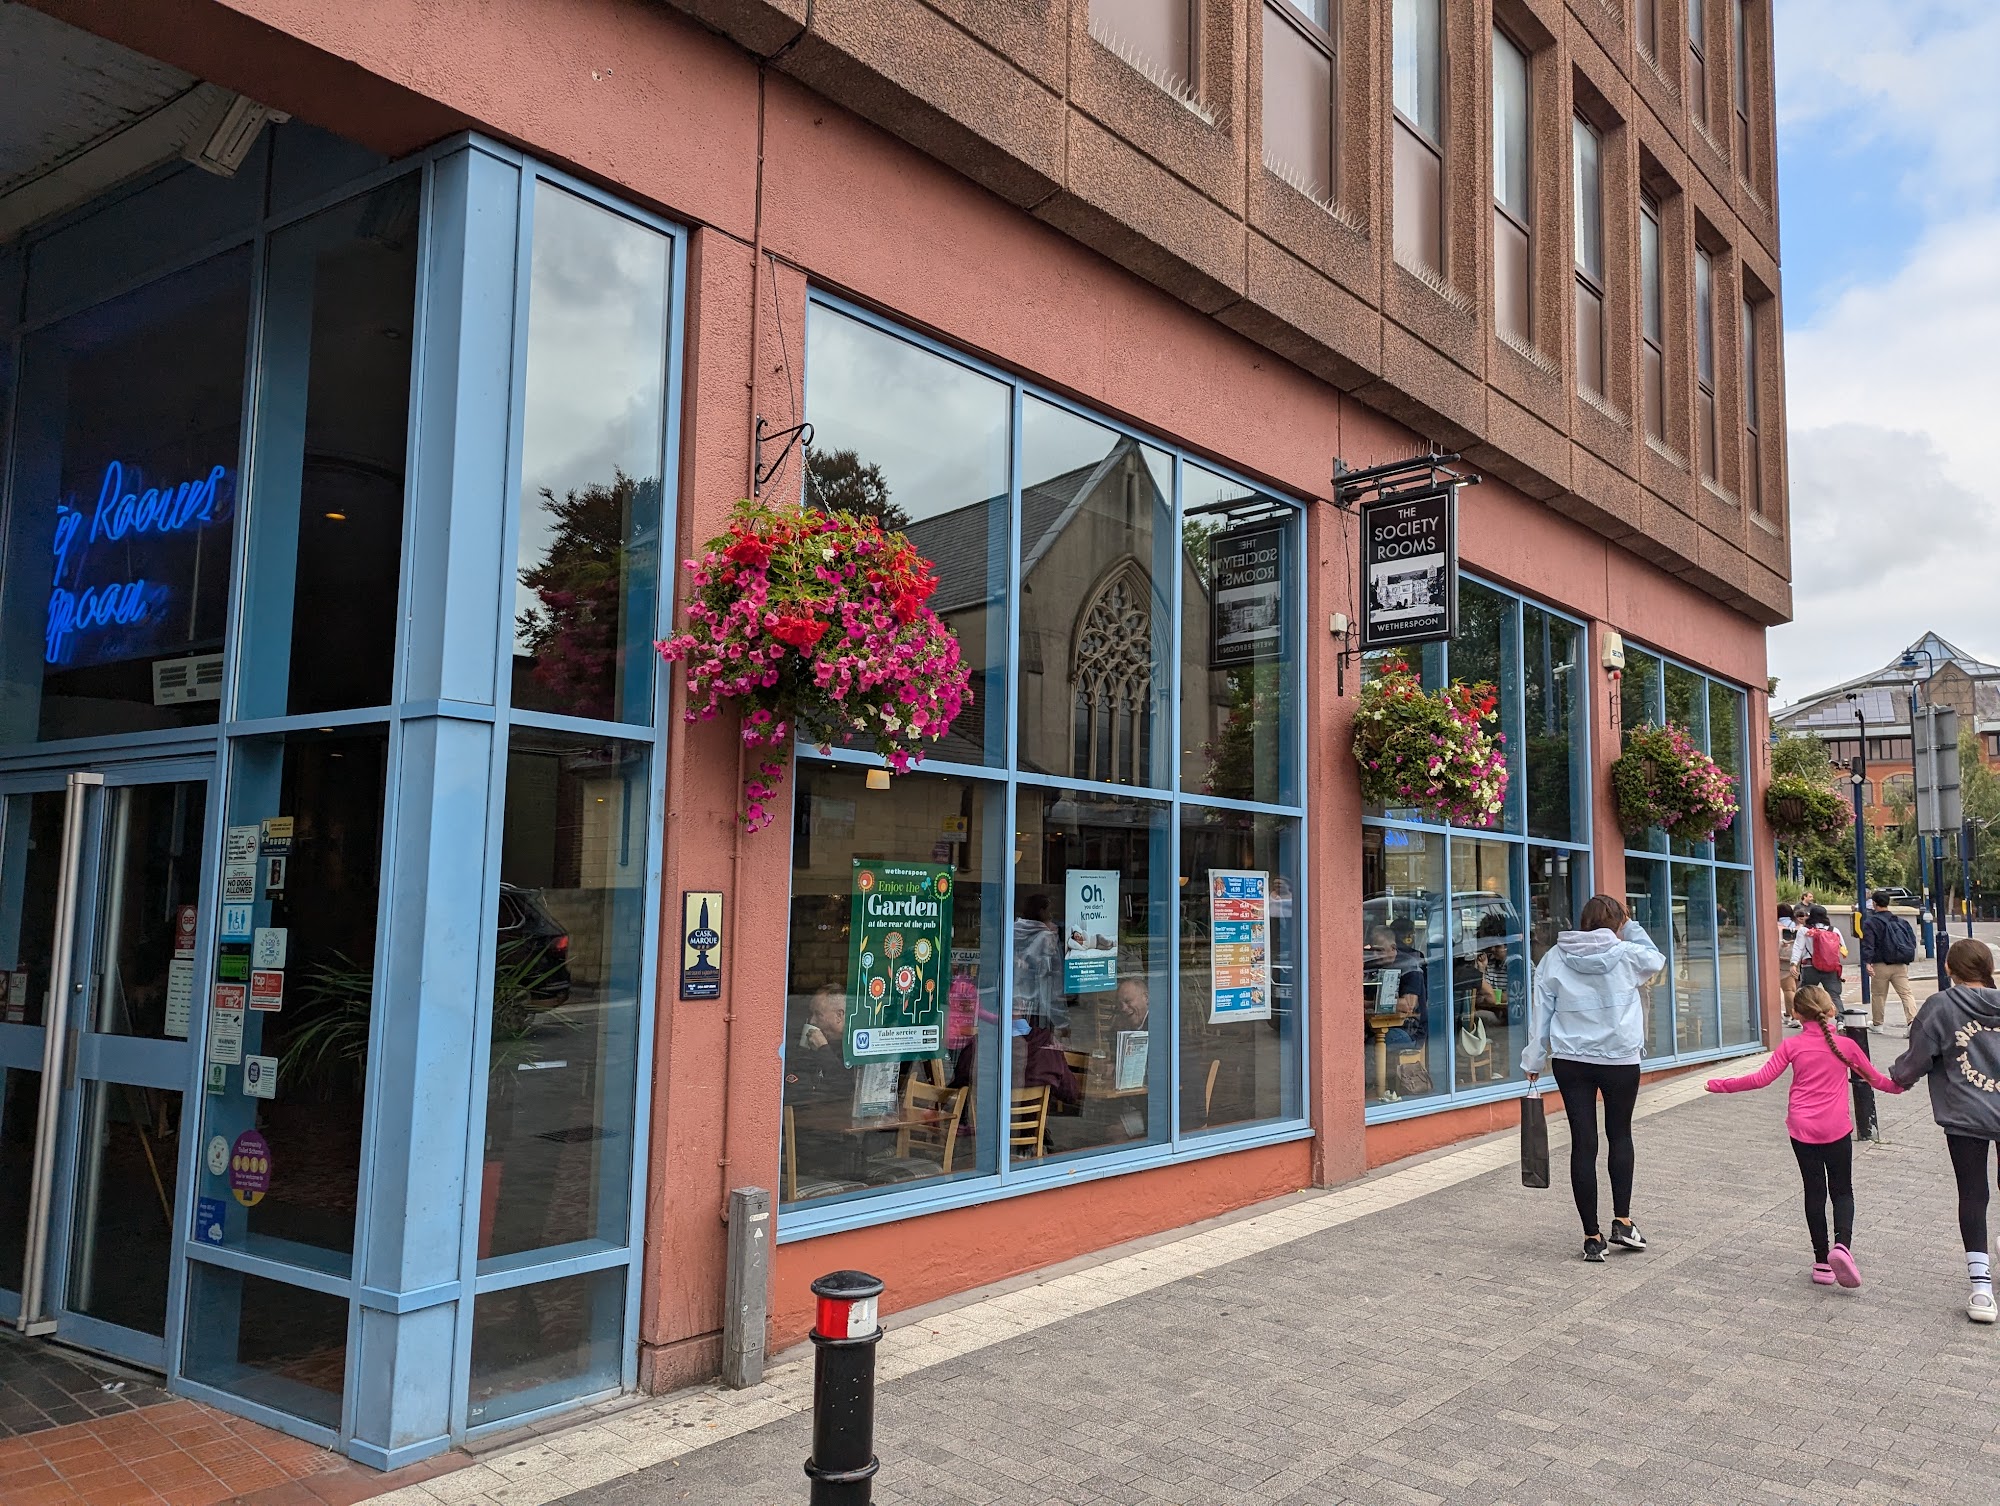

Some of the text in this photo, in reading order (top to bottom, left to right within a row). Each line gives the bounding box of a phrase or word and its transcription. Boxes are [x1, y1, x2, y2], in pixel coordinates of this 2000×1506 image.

[89, 460, 226, 544] Rooms
[1397, 507, 1417, 519] THE
[1374, 516, 1439, 541] SOCIETY
[1377, 536, 1436, 560] ROOMS
[1376, 617, 1439, 632] WETHERSPOON
[884, 867, 928, 877] wetherspoon
[878, 880, 920, 895] Enjoy the
[1080, 884, 1106, 903] Oh,
[867, 893, 939, 917] Garden
[868, 920, 876, 928] at
[876, 919, 887, 928] the
[903, 919, 912, 928] of
[911, 920, 922, 929] the
[923, 920, 936, 930] pub
[694, 929, 712, 938] CASK
[689, 936, 718, 945] MARQUE
[877, 1029, 895, 1037] Table
[895, 1028, 917, 1036] service
[858, 1036, 867, 1045] W
[240, 1140, 262, 1149] Community
